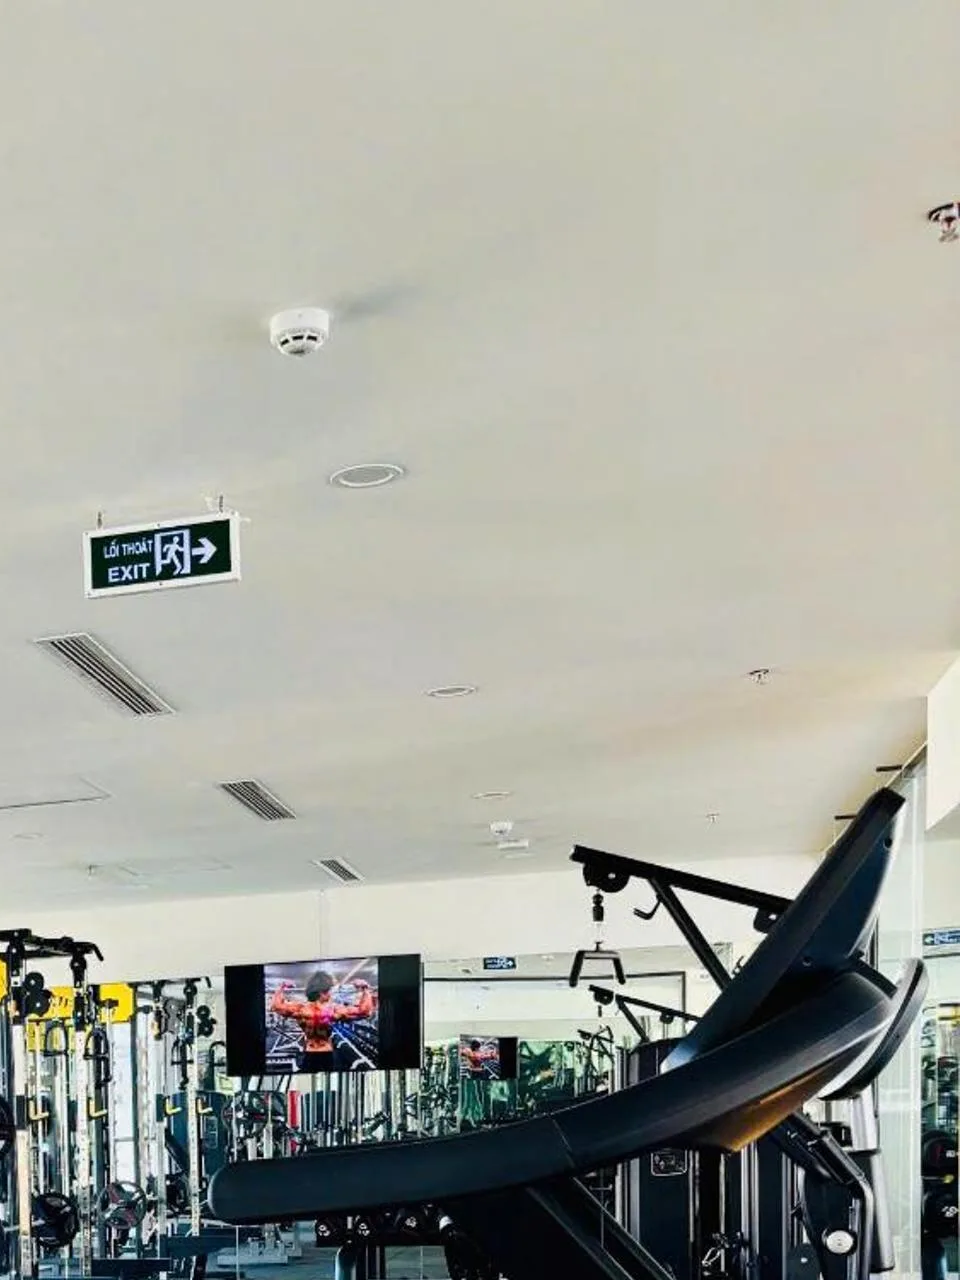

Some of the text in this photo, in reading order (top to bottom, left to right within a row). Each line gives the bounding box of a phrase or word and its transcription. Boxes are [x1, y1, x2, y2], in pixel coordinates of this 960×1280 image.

[103, 537, 153, 559] LỐI THOÁT
[107, 562, 150, 583] EXIT
